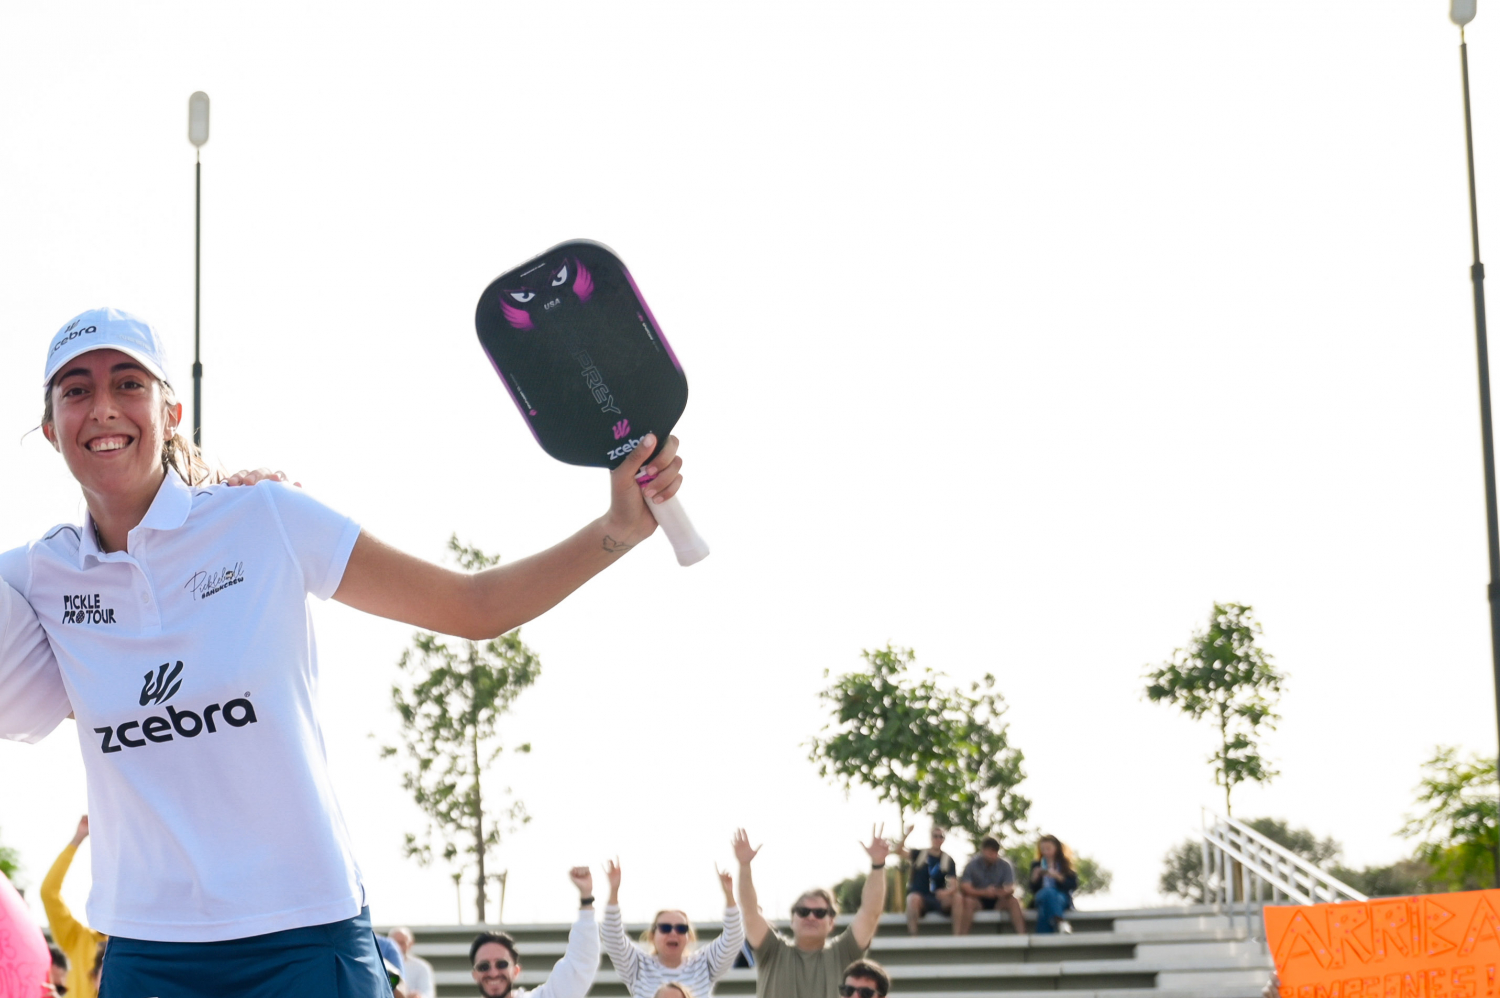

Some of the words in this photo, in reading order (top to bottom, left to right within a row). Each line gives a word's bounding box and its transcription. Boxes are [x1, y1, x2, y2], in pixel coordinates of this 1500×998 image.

[543, 298, 561, 310] USA
[607, 435, 646, 461] zceb
[63, 593, 101, 610] PICKLE
[1275, 895, 1500, 973] ARRIBA
